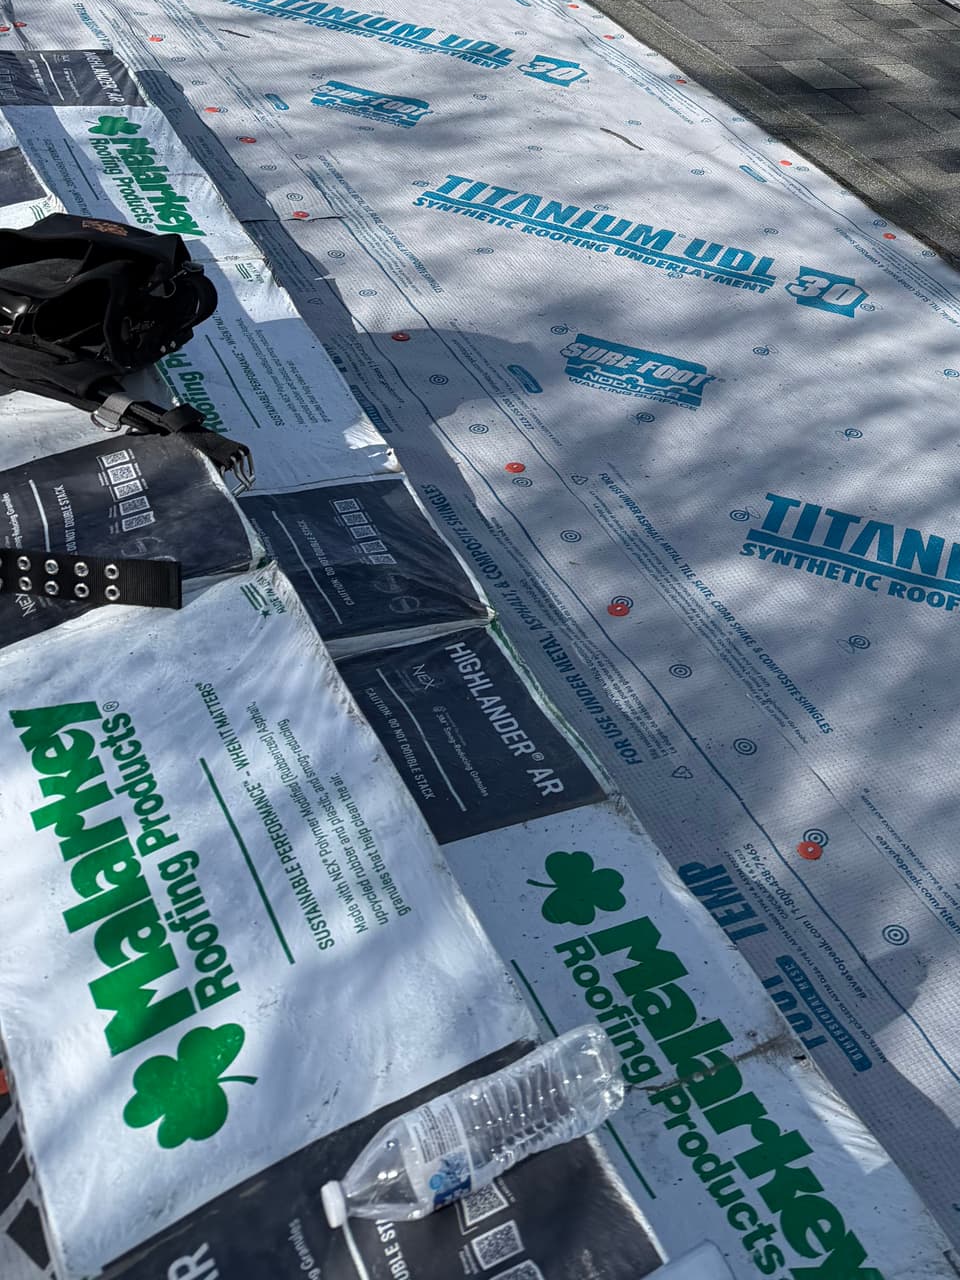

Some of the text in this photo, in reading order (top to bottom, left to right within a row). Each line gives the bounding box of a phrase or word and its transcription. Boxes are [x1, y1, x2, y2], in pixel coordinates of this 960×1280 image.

[440, 34, 516, 63] UDL
[518, 61, 588, 85] 30
[89, 138, 124, 175] Roofing
[108, 138, 207, 236] Malarkey
[412, 196, 771, 295] SYNTHETIC ROOFING UNDERLAYMENT
[437, 173, 868, 311] TITANIUM UDL 30
[560, 340, 714, 388] SURE-FOOT
[53, 484, 70, 505] STACK
[59, 504, 75, 527] DOUBLE
[417, 478, 463, 530] SHINGLES
[451, 522, 504, 583] COMPOSITE
[740, 542, 880, 593] SYNTHETIC
[502, 587, 546, 636] ASPHALT,
[616, 491, 642, 517] UNDER
[710, 597, 734, 623] CEDAR
[757, 650, 800, 698] COMPOSITE
[794, 692, 834, 736] SHINGLES
[413, 662, 437, 691] NEX
[534, 629, 578, 677] METAL,
[243, 700, 270, 735] Asphalt,
[364, 684, 393, 720] CAUTION:
[563, 670, 606, 718] UNDER
[392, 727, 407, 744] NOT
[594, 710, 623, 742] USE
[222, 735, 251, 771] WHEN
[396, 741, 424, 775] DOUBLE
[527, 756, 564, 797] AR
[612, 735, 644, 770] FOR
[285, 779, 314, 819] Modified
[412, 771, 437, 802] STACK
[274, 716, 392, 926] upcycled rubber and plastic, and smog-reducing
[303, 813, 335, 857] Polymer
[326, 770, 412, 918] granules that help clean the air.
[8, 701, 197, 1057] Malarkey
[333, 879, 356, 906] with
[674, 845, 772, 952] TEMP
[739, 841, 803, 915] 1-800-438-7465
[157, 848, 241, 1013] Roofing
[281, 861, 339, 952] SUSTAINABLE
[343, 901, 370, 935] Made
[553, 935, 663, 1084] Roofing
[804, 992, 864, 1063] DIMENSIONAL
